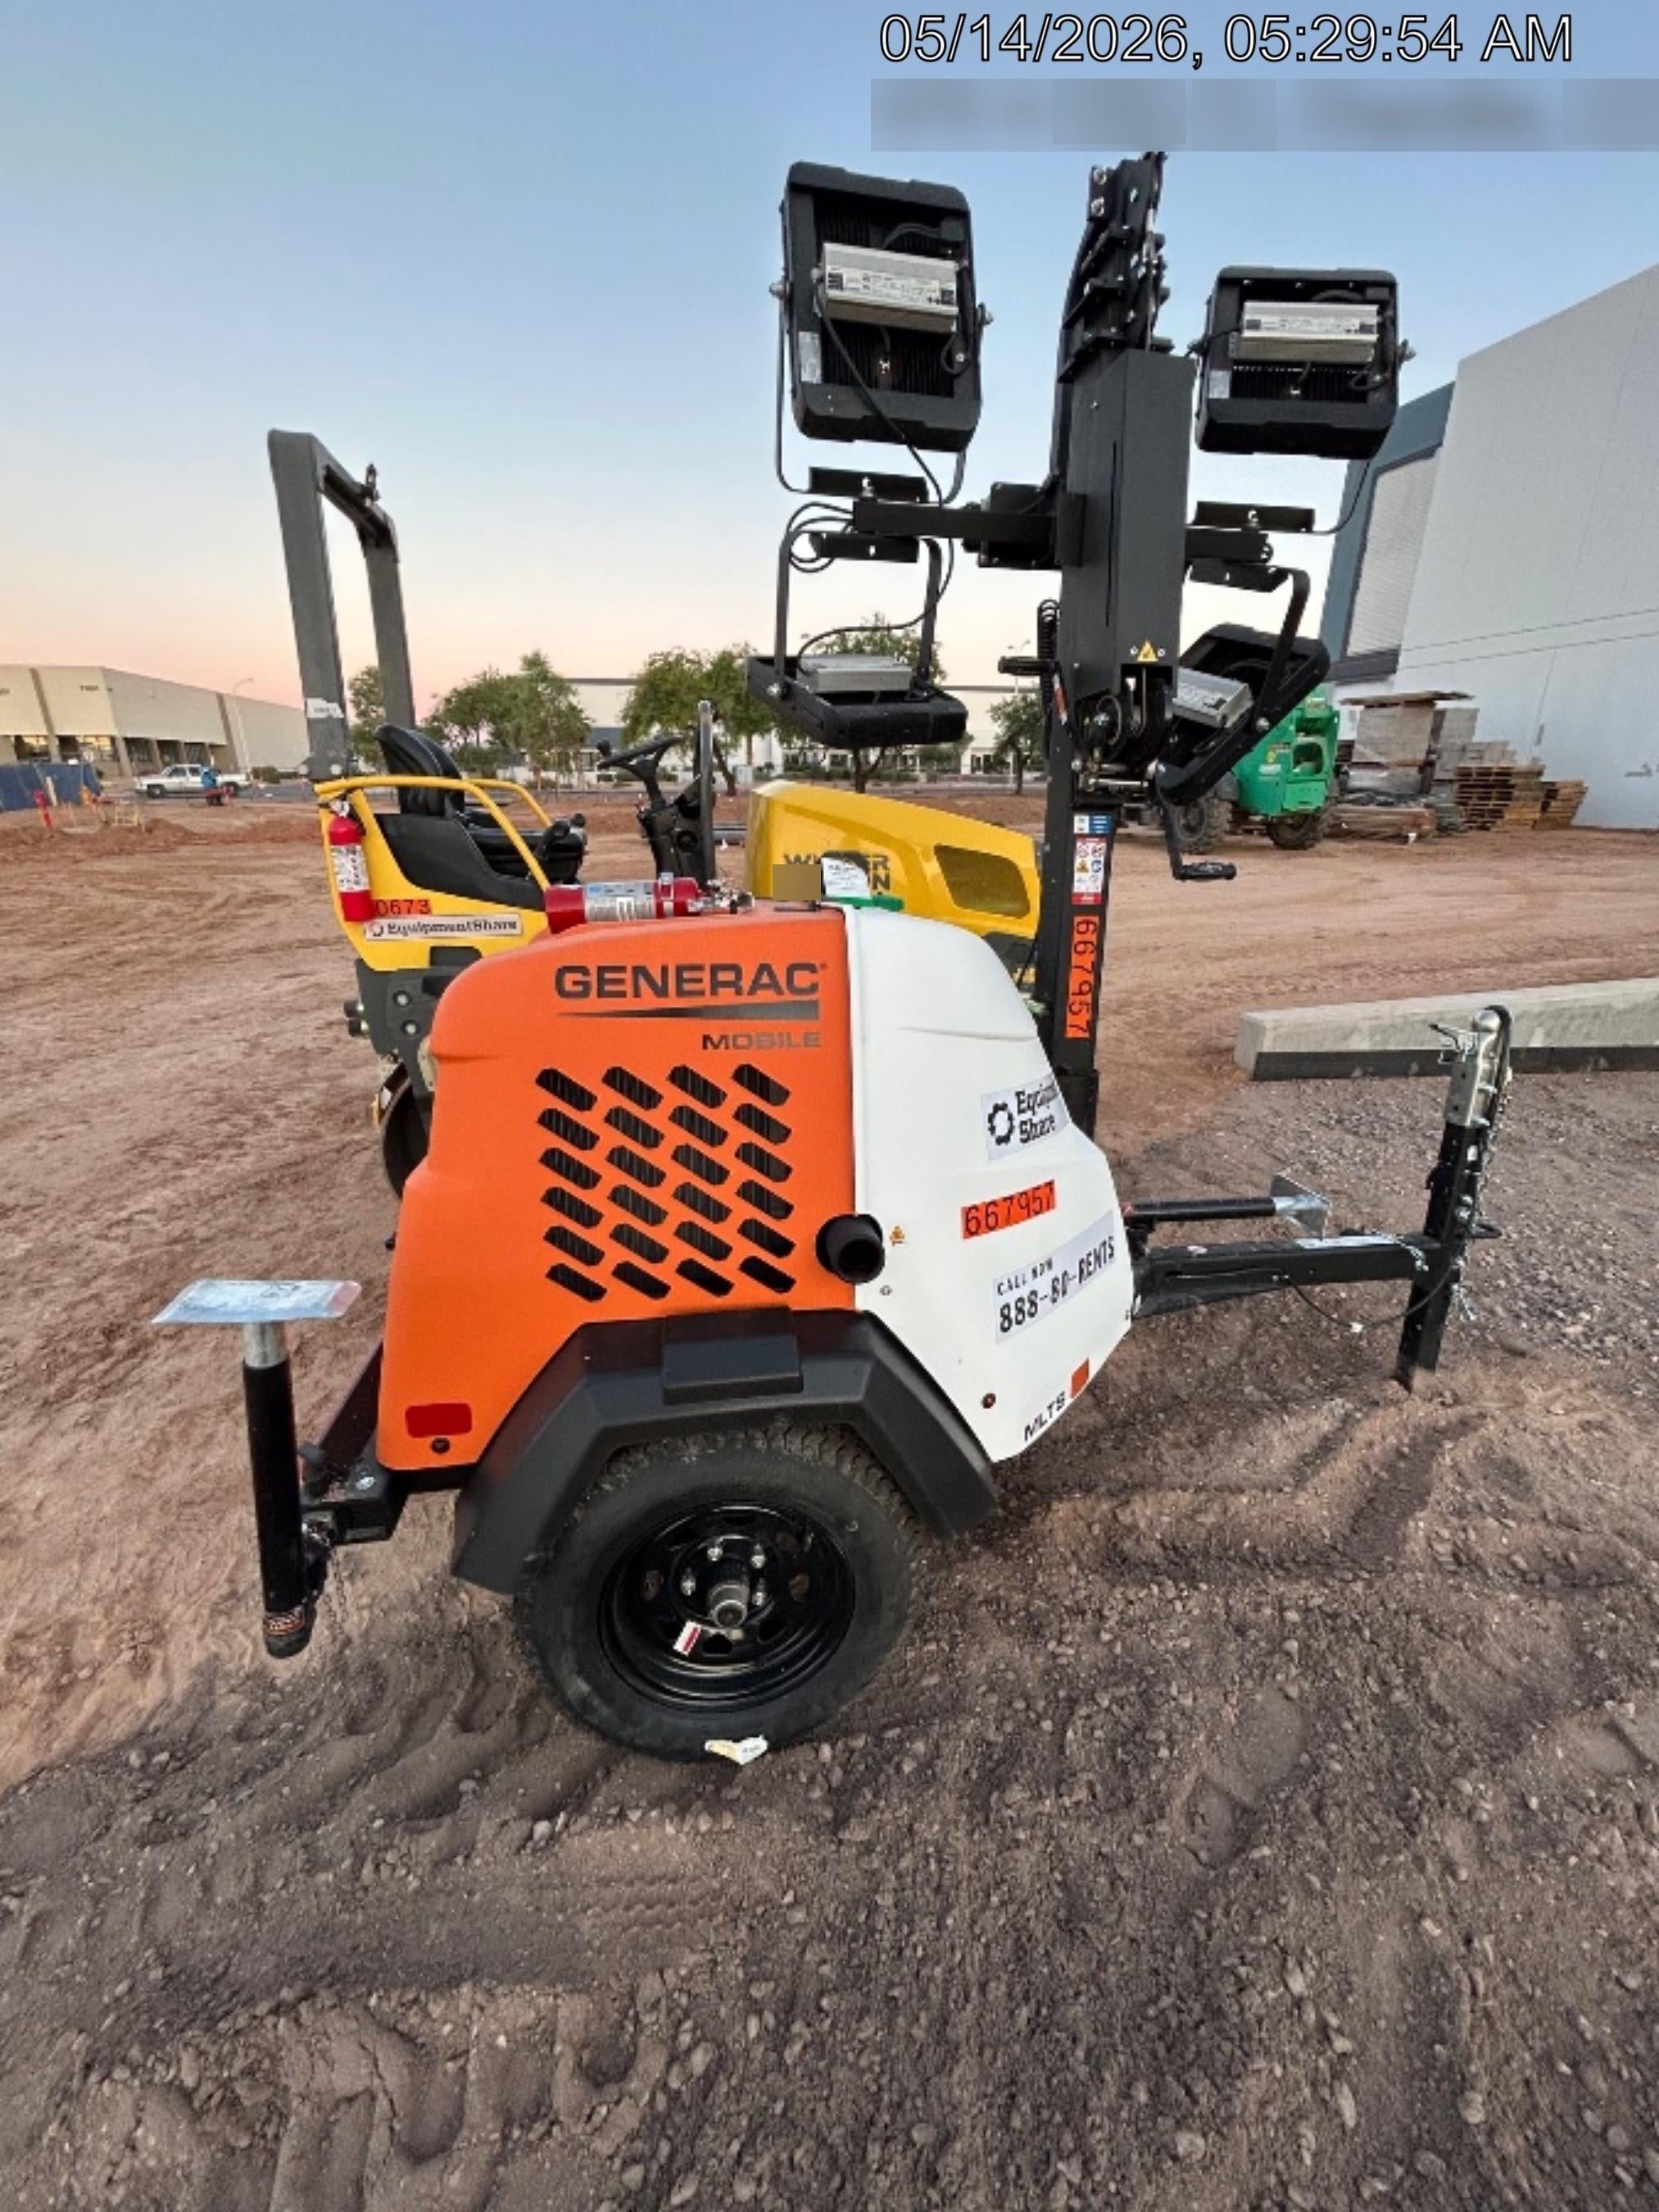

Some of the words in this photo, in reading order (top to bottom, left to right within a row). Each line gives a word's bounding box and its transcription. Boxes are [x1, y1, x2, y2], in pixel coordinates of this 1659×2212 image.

[387, 918, 518, 937] EquipmentShare
[555, 963, 819, 999] GENERAC
[1068, 918, 1098, 1034] 667957
[701, 1031, 821, 1050] MOBILE
[1019, 1114, 1056, 1144] Share
[964, 1180, 1054, 1236] 667957
[997, 1272, 1027, 1296] CALL
[1031, 1258, 1054, 1281] NOW
[999, 1235, 1114, 1333] 888-80-RENTS
